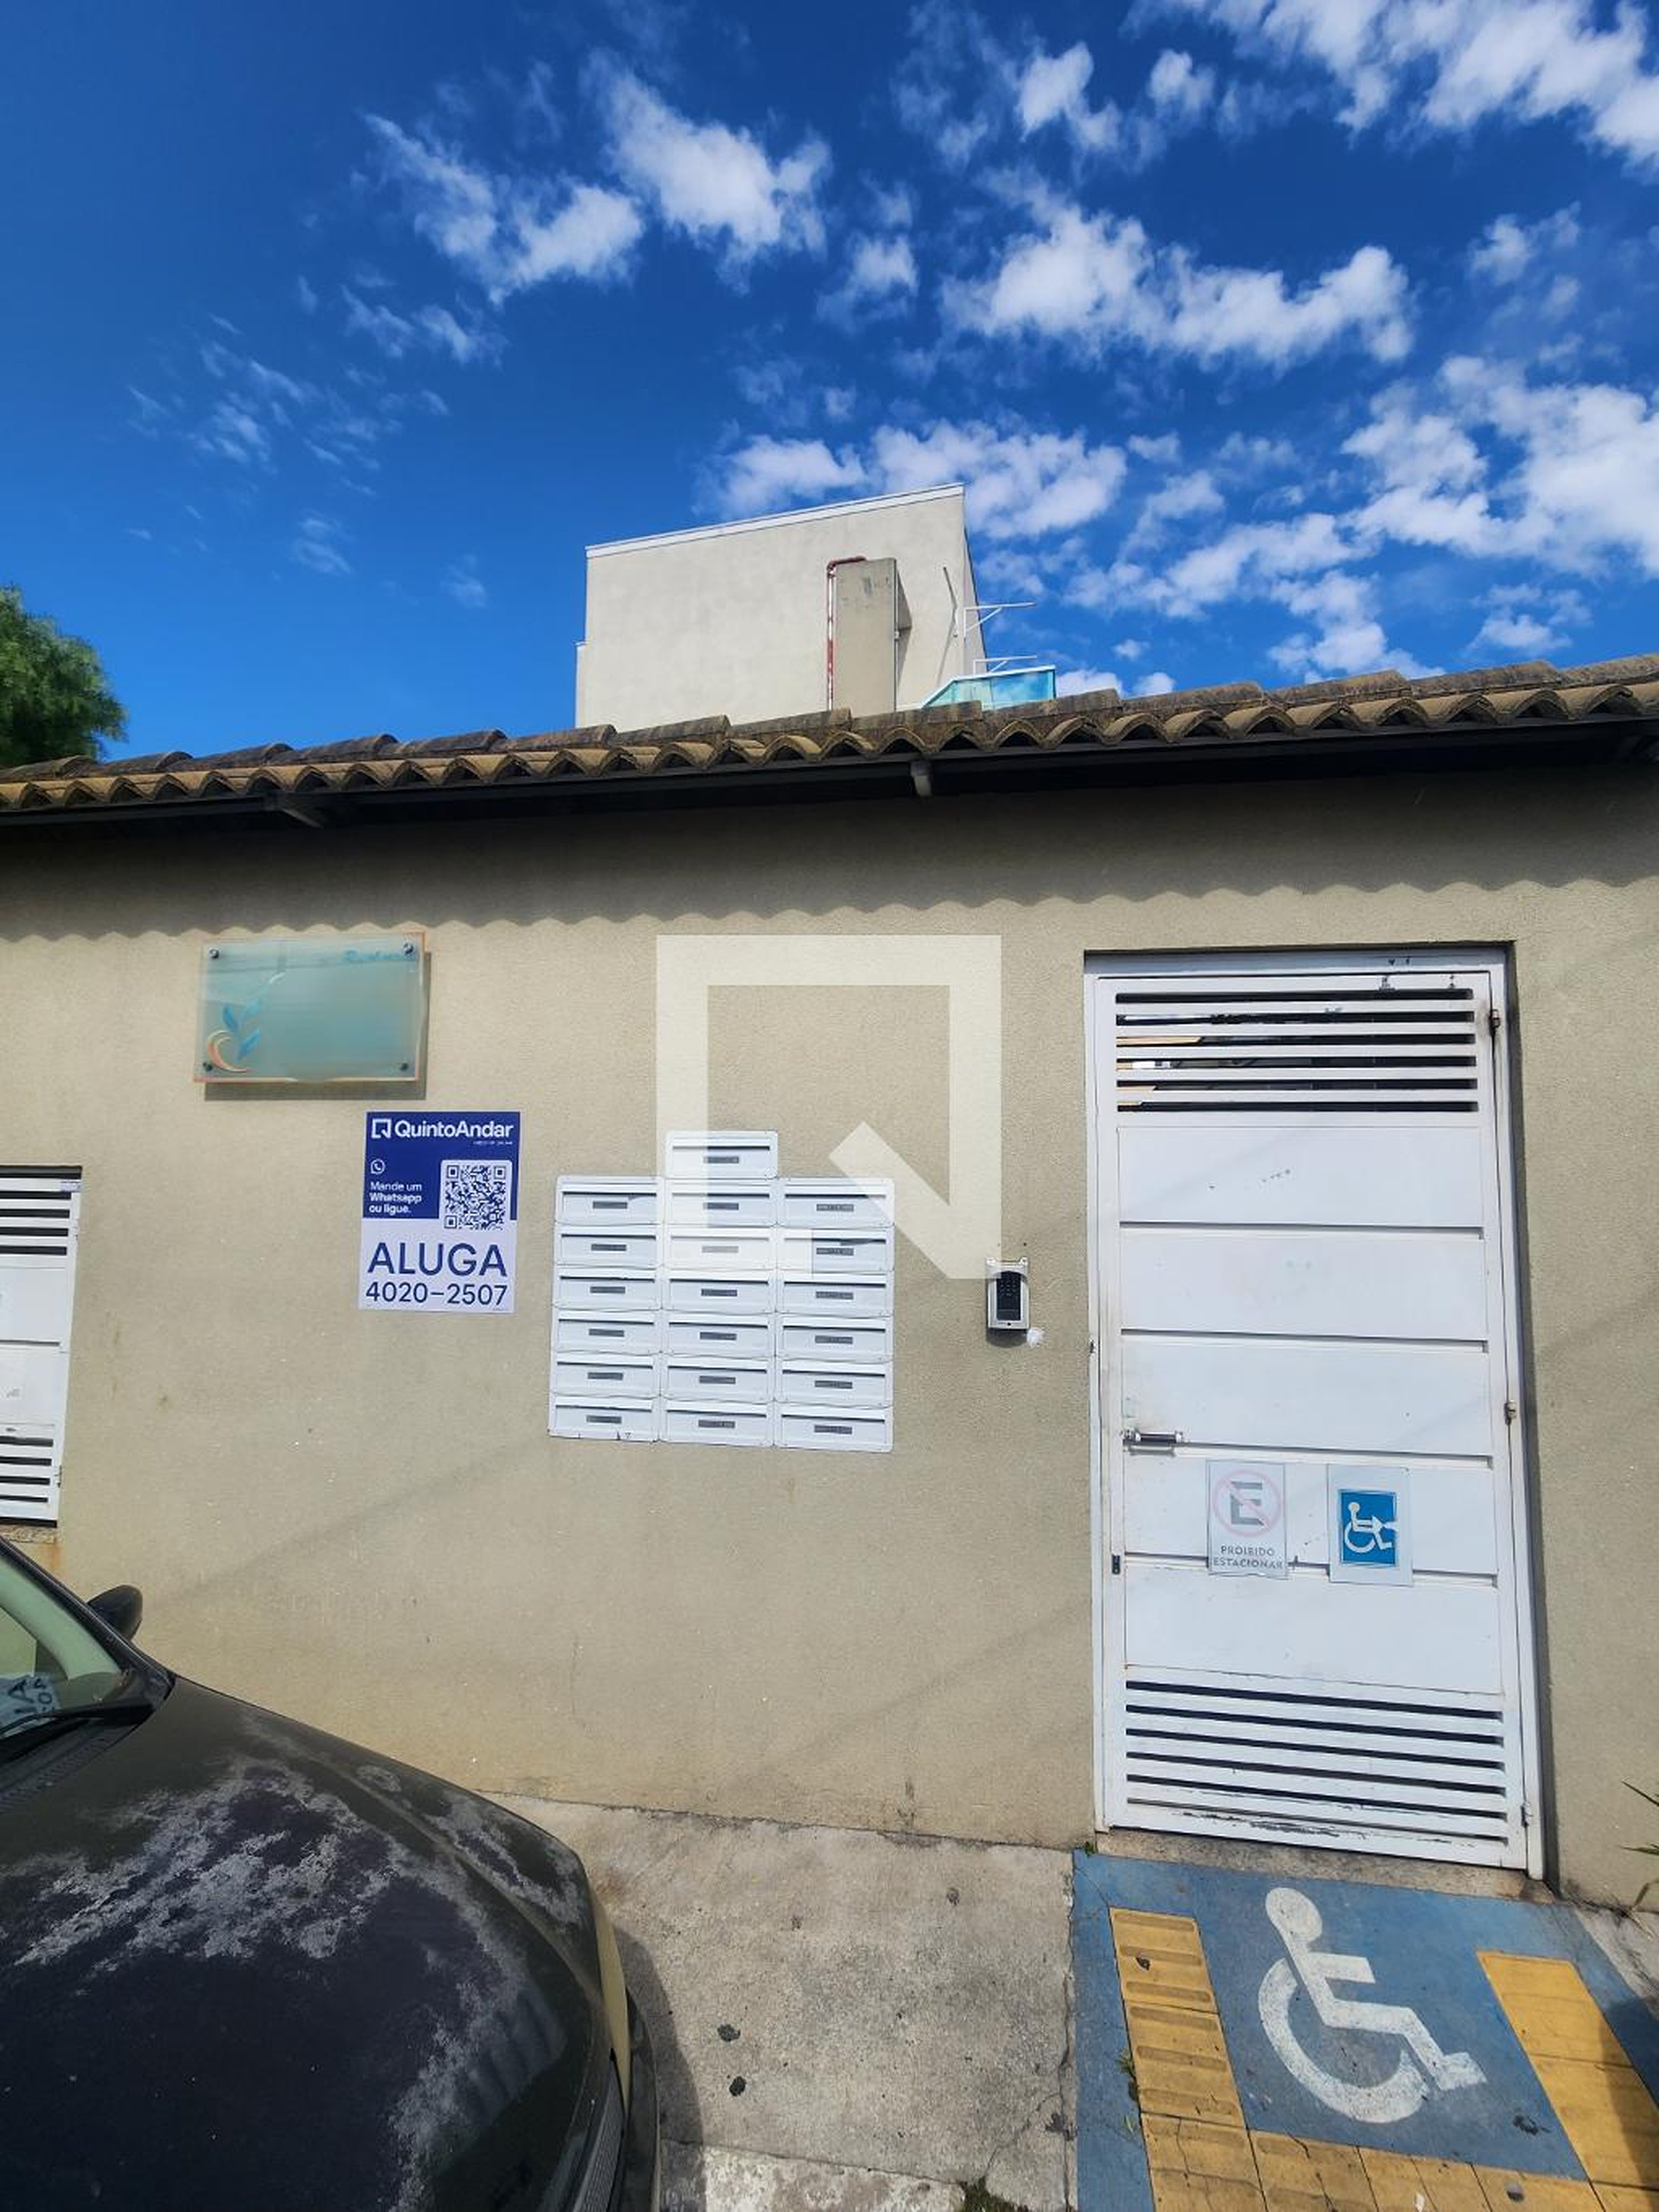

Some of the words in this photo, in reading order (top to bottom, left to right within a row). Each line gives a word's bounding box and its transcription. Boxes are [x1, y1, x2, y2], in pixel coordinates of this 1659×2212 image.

[394, 1120, 513, 1138] QuintoAndar
[370, 1181, 404, 1191] Mande
[369, 1193, 422, 1204] Whatsapp
[369, 1205, 382, 1213] ou
[384, 1203, 411, 1216] ligue.
[368, 1242, 507, 1277] ALUGA
[366, 1282, 507, 1305] 4020-2507
[1221, 1546, 1274, 1556] PROIBIDO
[1213, 1557, 1283, 1569] ESTACIONAR
